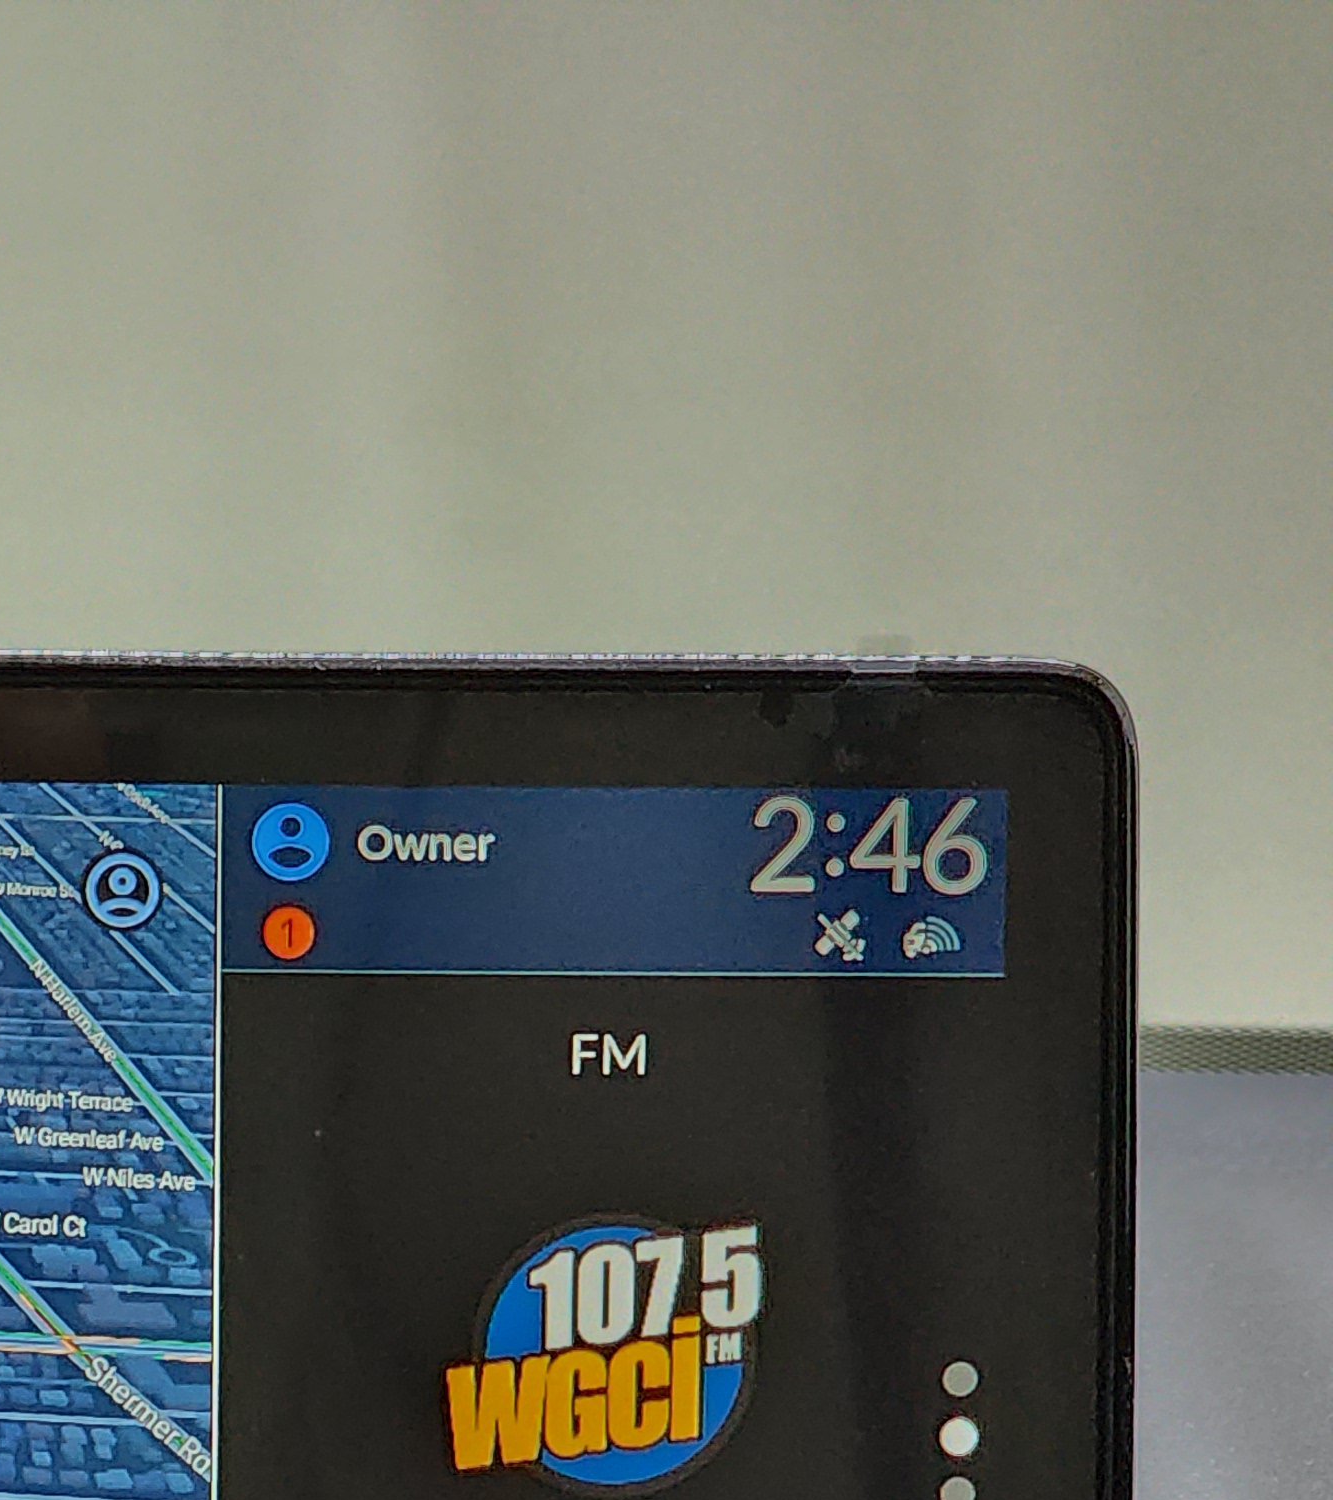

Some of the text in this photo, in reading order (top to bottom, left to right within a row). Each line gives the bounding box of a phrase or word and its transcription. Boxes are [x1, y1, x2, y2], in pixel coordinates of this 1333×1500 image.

[356, 823, 496, 862] Owner
[749, 796, 988, 894] 2:46
[283, 917, 297, 949] 1
[42, 972, 93, 1033] Harlem
[89, 1029, 118, 1063] Ave
[570, 1034, 648, 1076] FM
[5, 1089, 65, 1113] Wright
[66, 1090, 134, 1113] Terrace
[14, 1126, 166, 1152] W Greenleaf Ave
[82, 1166, 198, 1192] W Niles Ave
[3, 1211, 59, 1236] Carol
[62, 1214, 88, 1238] Ct
[705, 1333, 742, 1366] FM
[84, 1355, 180, 1447] Shermer
